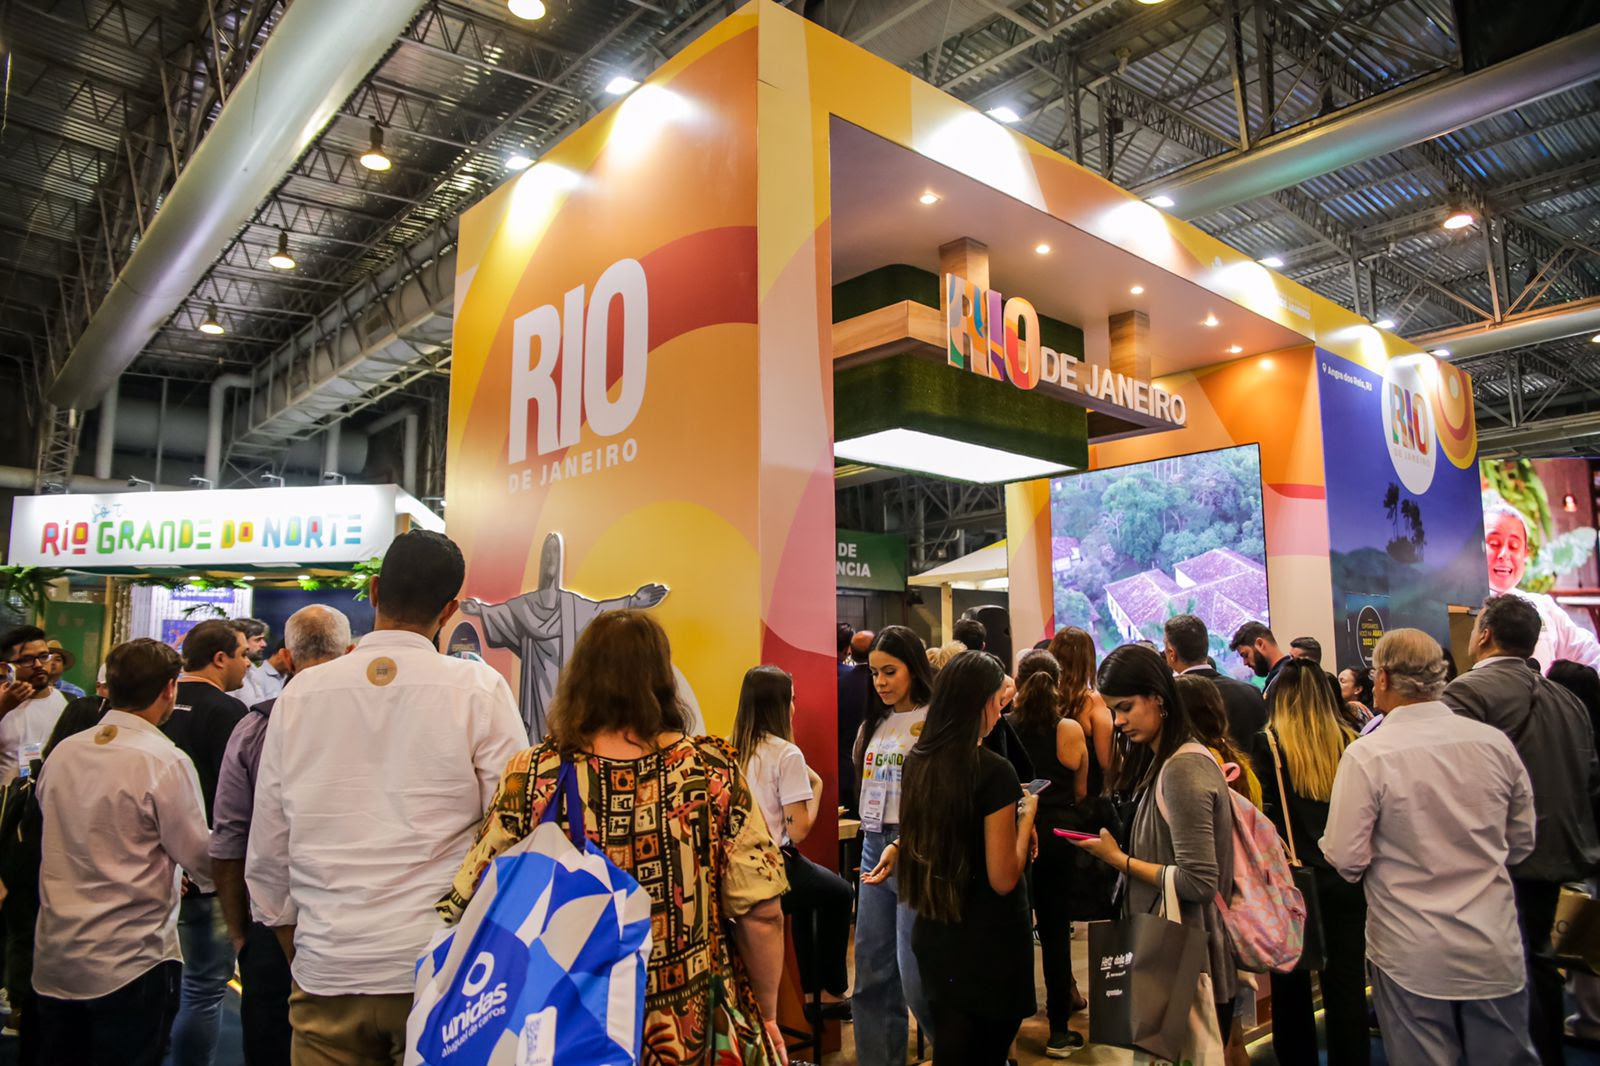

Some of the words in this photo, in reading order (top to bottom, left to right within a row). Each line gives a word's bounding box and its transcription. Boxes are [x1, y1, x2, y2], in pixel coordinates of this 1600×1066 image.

[508, 258, 648, 465] RIO
[946, 273, 1041, 390] RIO
[1040, 346, 1078, 391] DE
[1084, 364, 1187, 426] JANEIRO
[1389, 382, 1430, 456] RIO
[508, 469, 532, 495] DE
[540, 438, 638, 487] JANEIRO
[96, 517, 212, 555] GRANDE
[220, 519, 254, 549] DO
[262, 513, 362, 549] NORTE
[837, 542, 857, 558] DE
[442, 982, 508, 1044] unidas
[478, 1005, 506, 1028] carros
